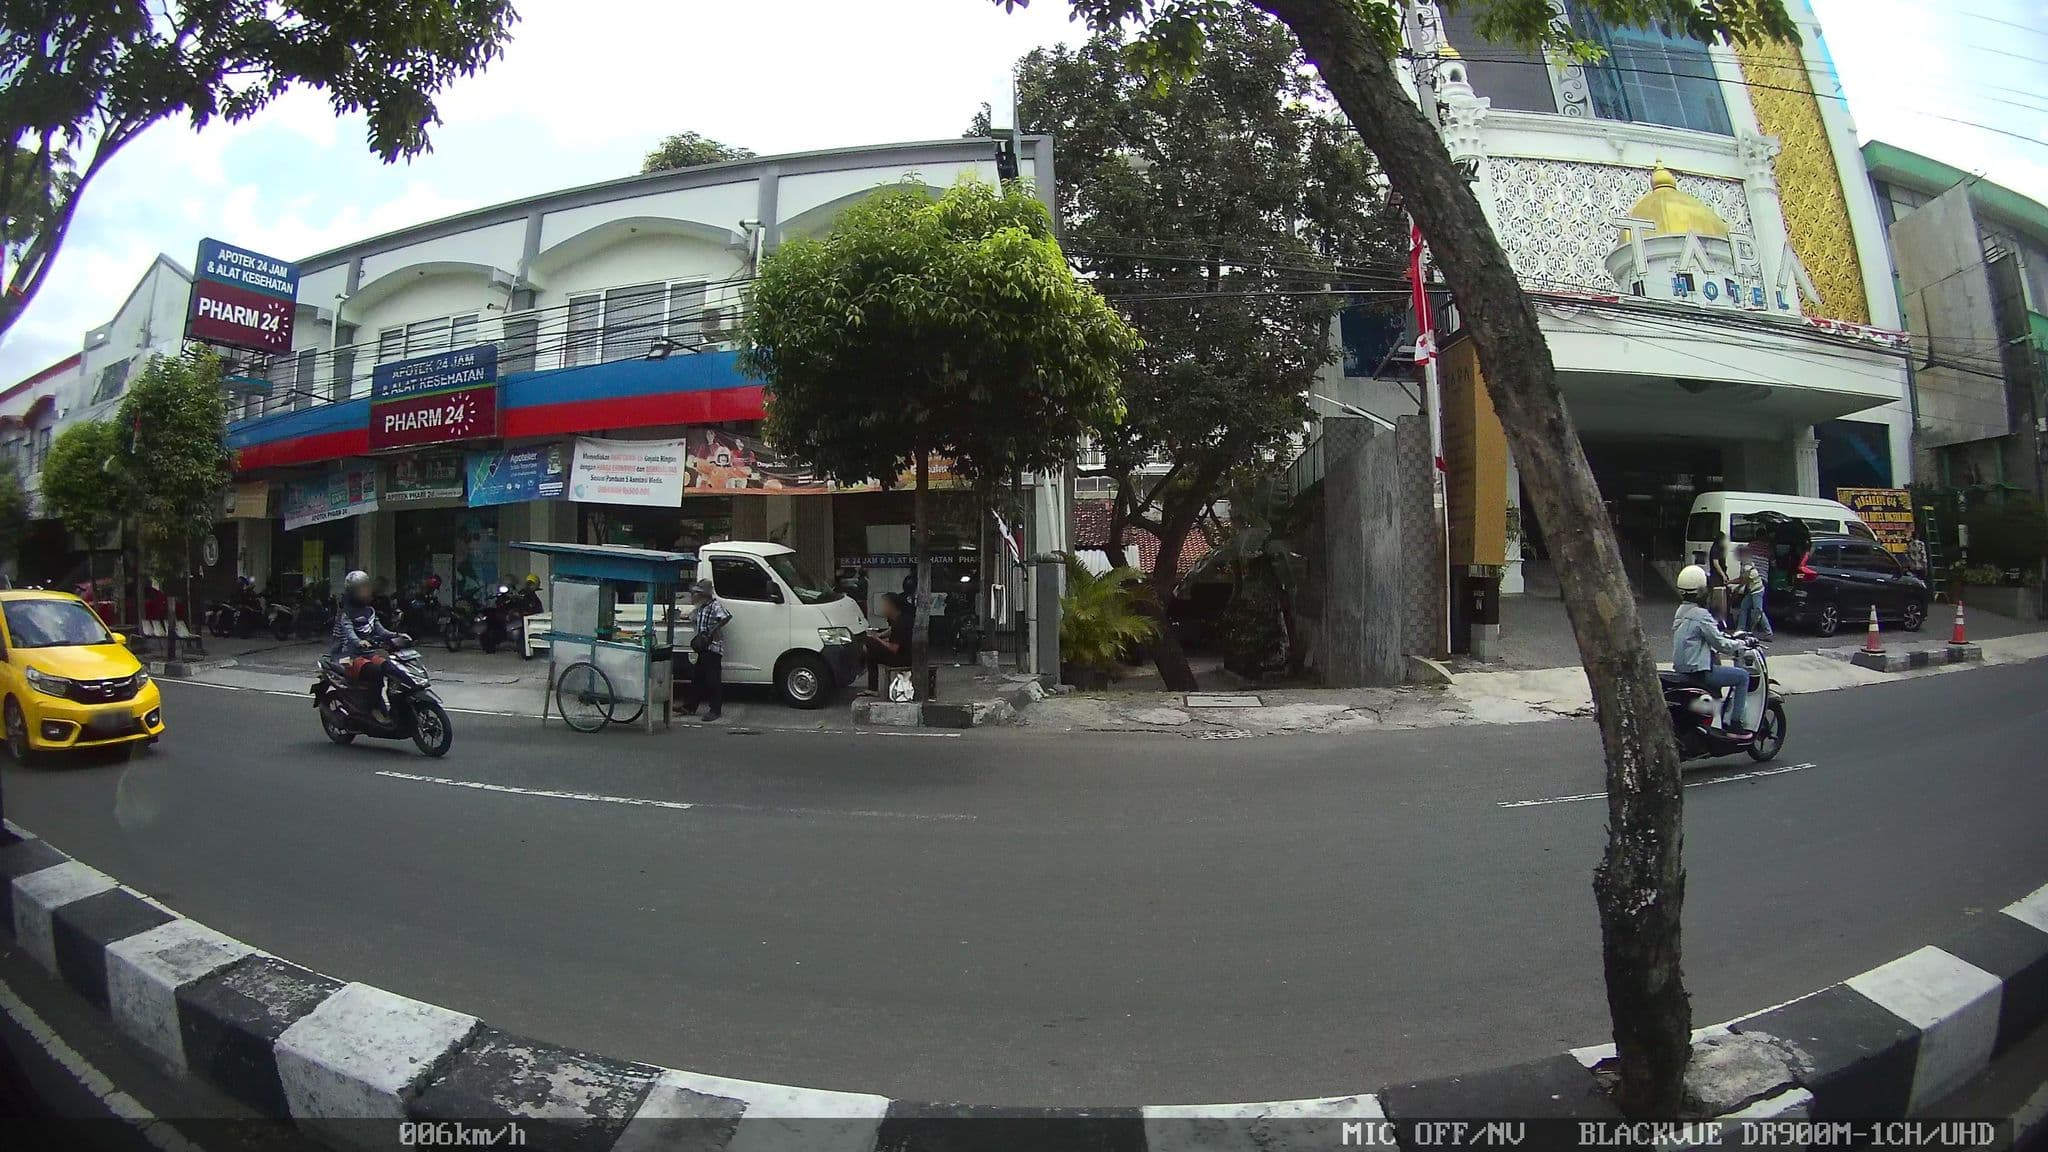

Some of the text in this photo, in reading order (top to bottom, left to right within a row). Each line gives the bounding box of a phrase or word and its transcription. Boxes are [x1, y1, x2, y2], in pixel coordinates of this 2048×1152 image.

[218, 249, 288, 278] APOTEK 24 JAM
[1614, 217, 1824, 304] TARA
[207, 261, 293, 295] & ALAT KESEHATAN
[1671, 274, 1790, 310] HOTEL
[198, 297, 280, 332] PHARM 24
[392, 353, 475, 379] APOTEK 24 JAM
[391, 379, 419, 395] ALAT
[420, 368, 484, 389] KESEHATAN
[385, 404, 464, 433] PHARM 24
[863, 557, 878, 565] JAM
[888, 556, 906, 564] ALAT
